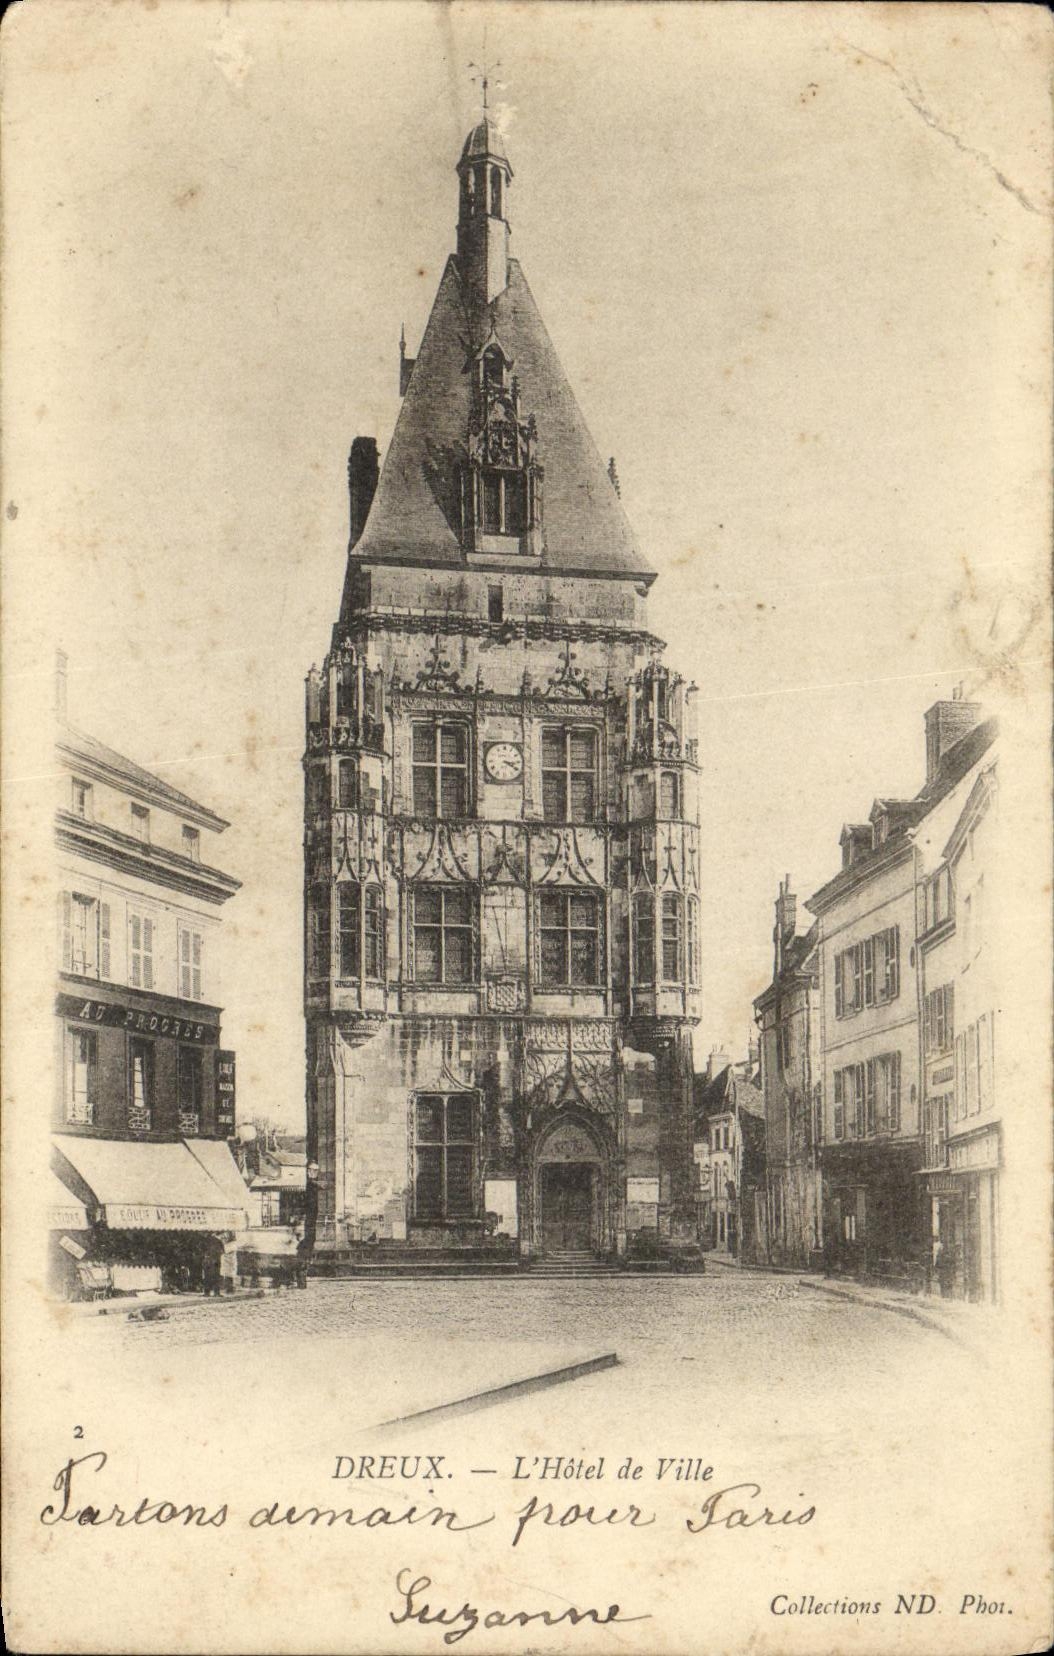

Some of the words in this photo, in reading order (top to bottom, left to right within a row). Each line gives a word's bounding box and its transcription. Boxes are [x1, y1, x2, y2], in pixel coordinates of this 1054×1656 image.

[79, 1001, 106, 1021] AU
[40, 1451, 228, 1527] Partons
[249, 1489, 495, 1532] demain
[511, 1496, 656, 1547] pour
[686, 1483, 816, 1534] Paris
[390, 1568, 652, 1645] Suzanne
